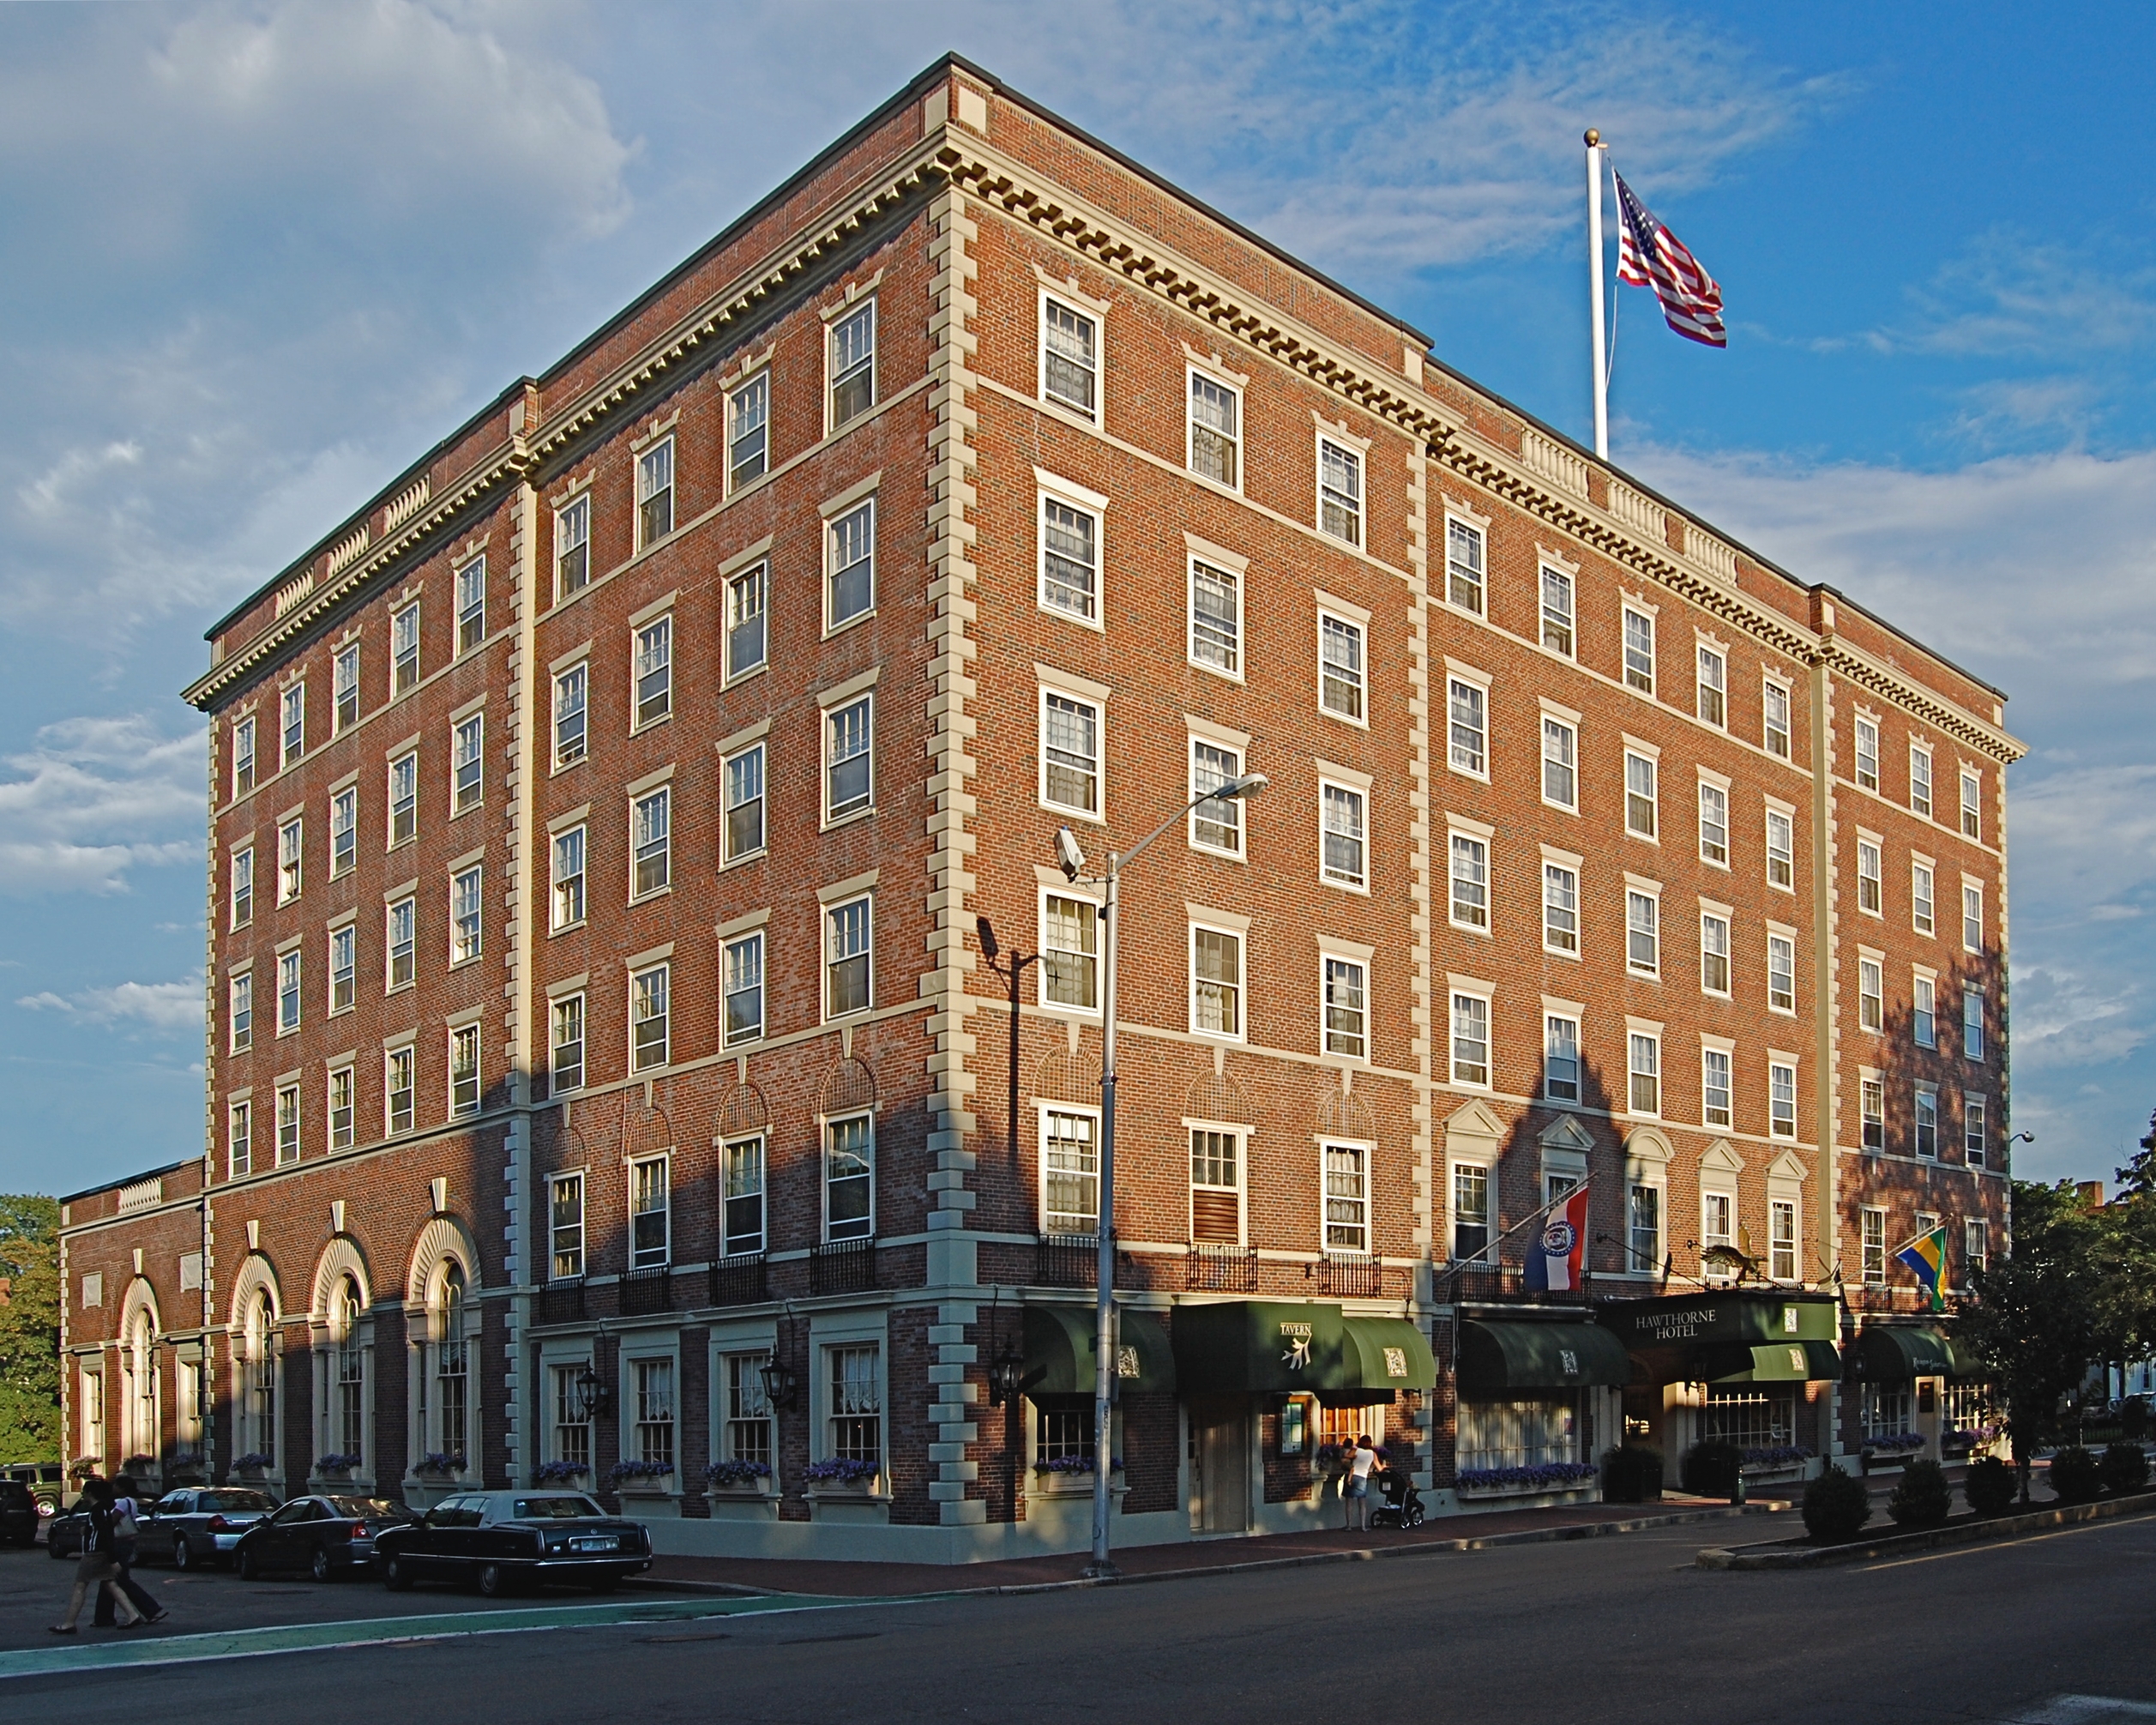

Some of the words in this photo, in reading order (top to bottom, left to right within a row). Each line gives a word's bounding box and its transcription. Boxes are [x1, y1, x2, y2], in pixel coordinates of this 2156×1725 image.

[1635, 1309, 1717, 1329] HAWTHORNE
[1280, 1324, 1311, 1336] TAVERN
[1656, 1324, 1698, 1339] HOTEL
